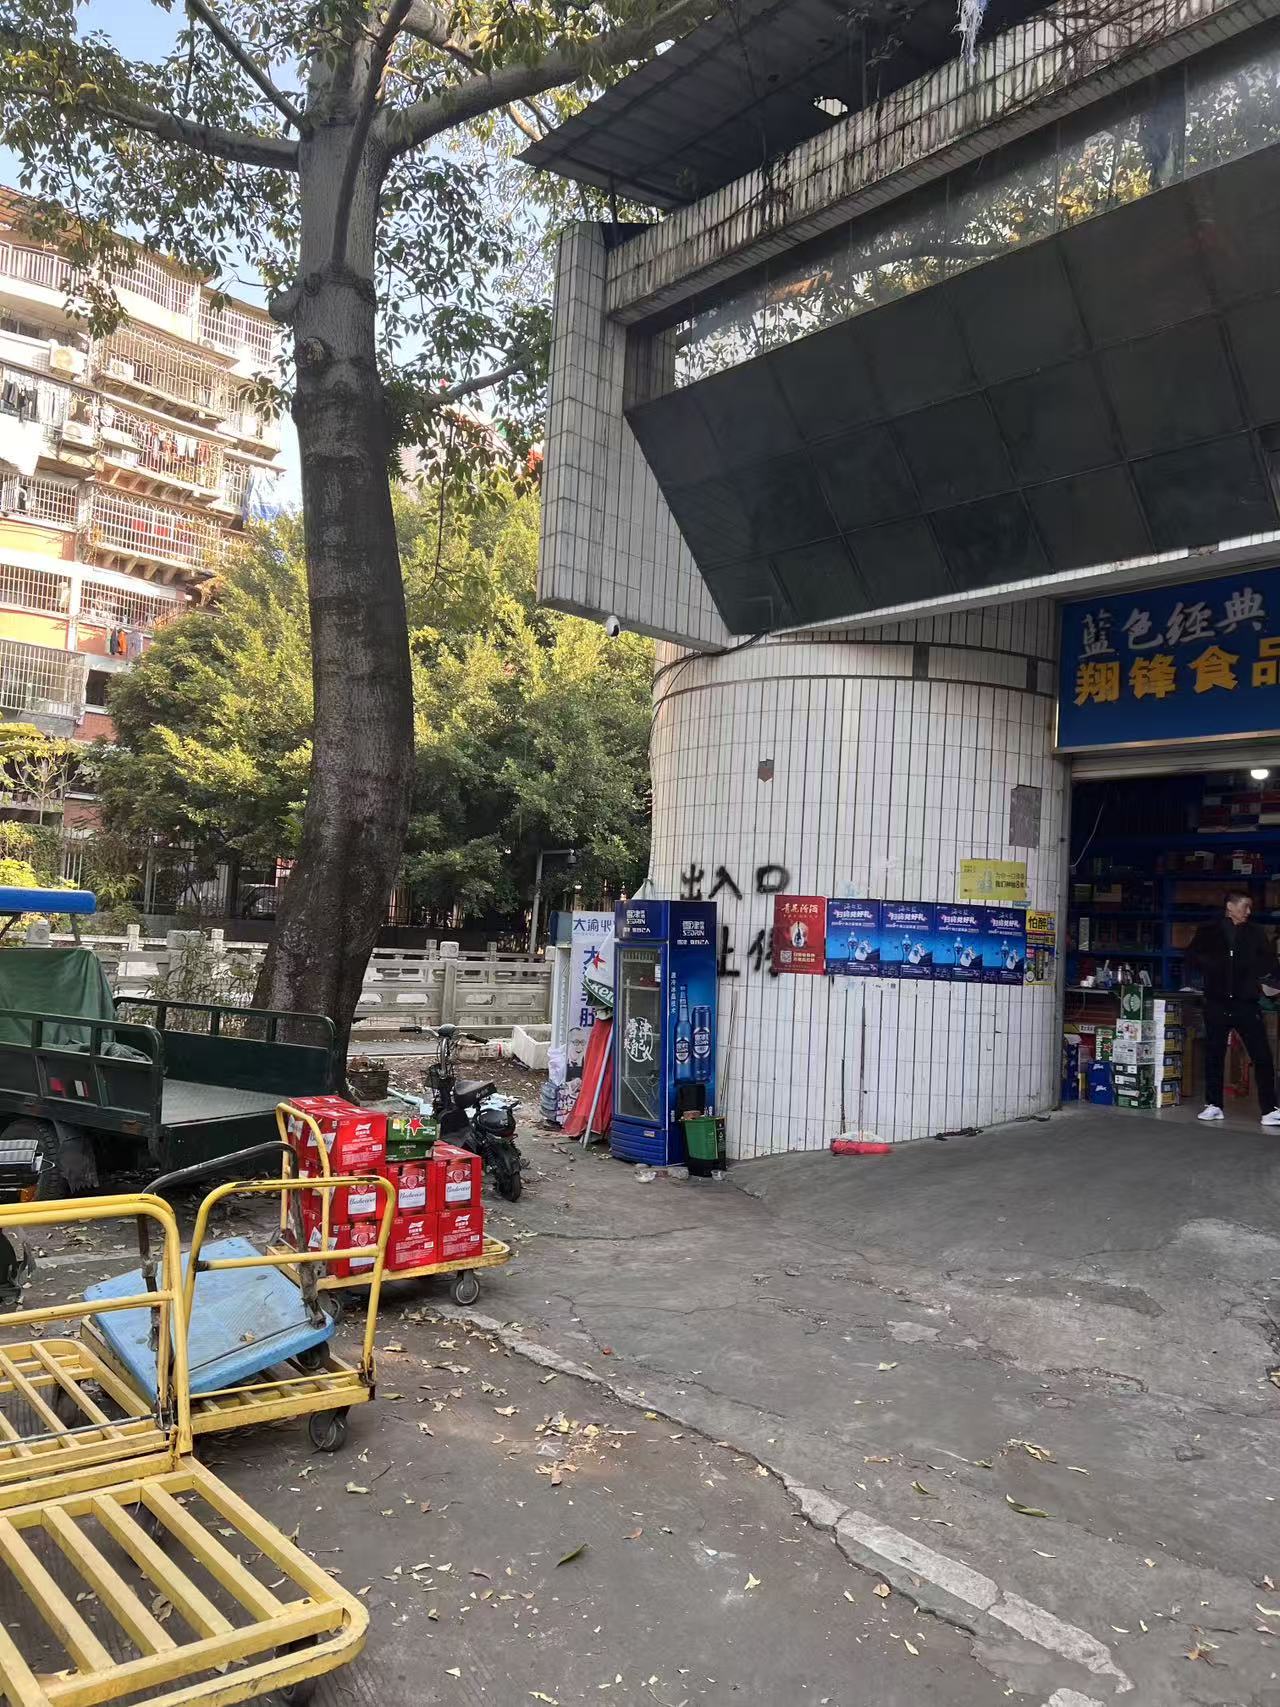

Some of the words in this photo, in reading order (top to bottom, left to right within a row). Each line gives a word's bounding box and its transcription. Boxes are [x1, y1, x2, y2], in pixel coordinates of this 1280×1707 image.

[1079, 588, 1267, 658] 藍色經典
[680, 863, 790, 900] 出入口
